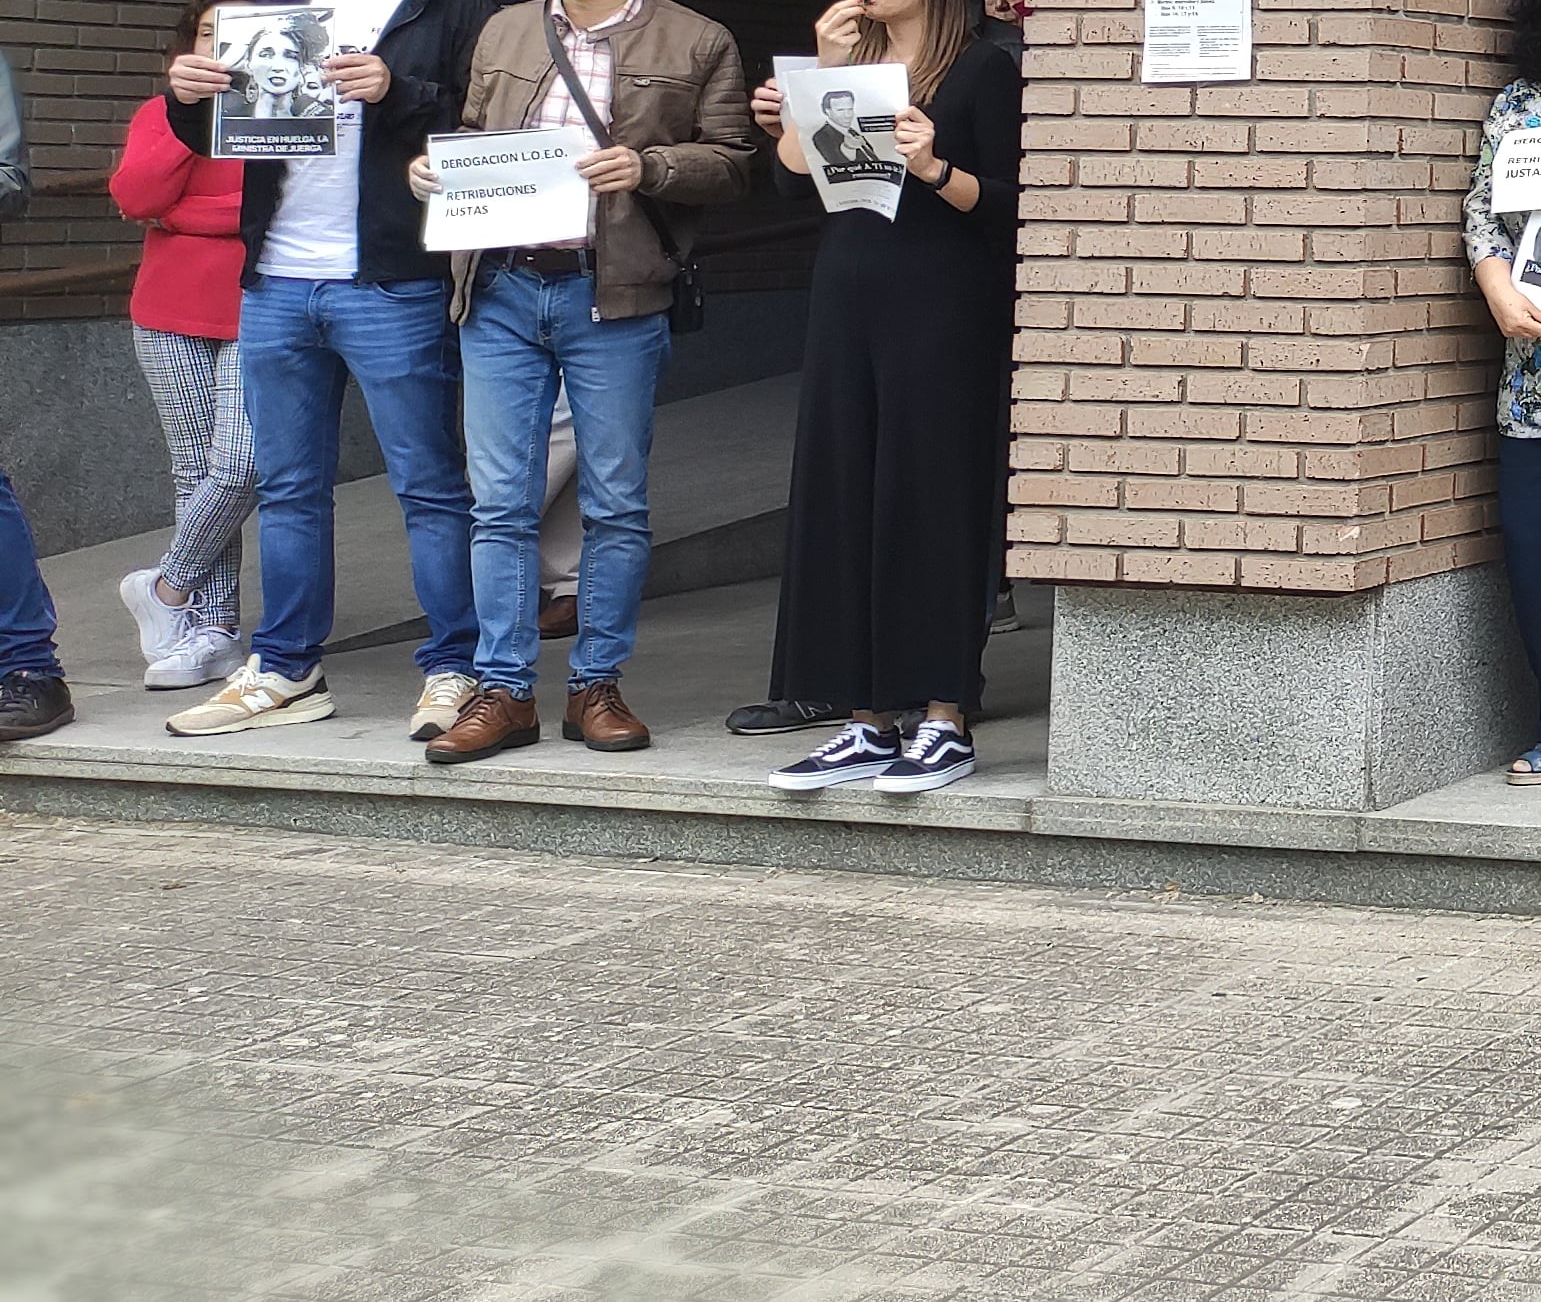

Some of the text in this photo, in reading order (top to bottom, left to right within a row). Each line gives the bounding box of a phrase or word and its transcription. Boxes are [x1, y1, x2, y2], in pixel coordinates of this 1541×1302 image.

[225, 135, 329, 144] JUSTICIA EN HUELGA LA
[231, 145, 274, 153] MINISTRA
[441, 152, 519, 170] DEROGACION
[446, 183, 537, 201] RETRIBUCIONES
[445, 205, 489, 217] JUSTAS
